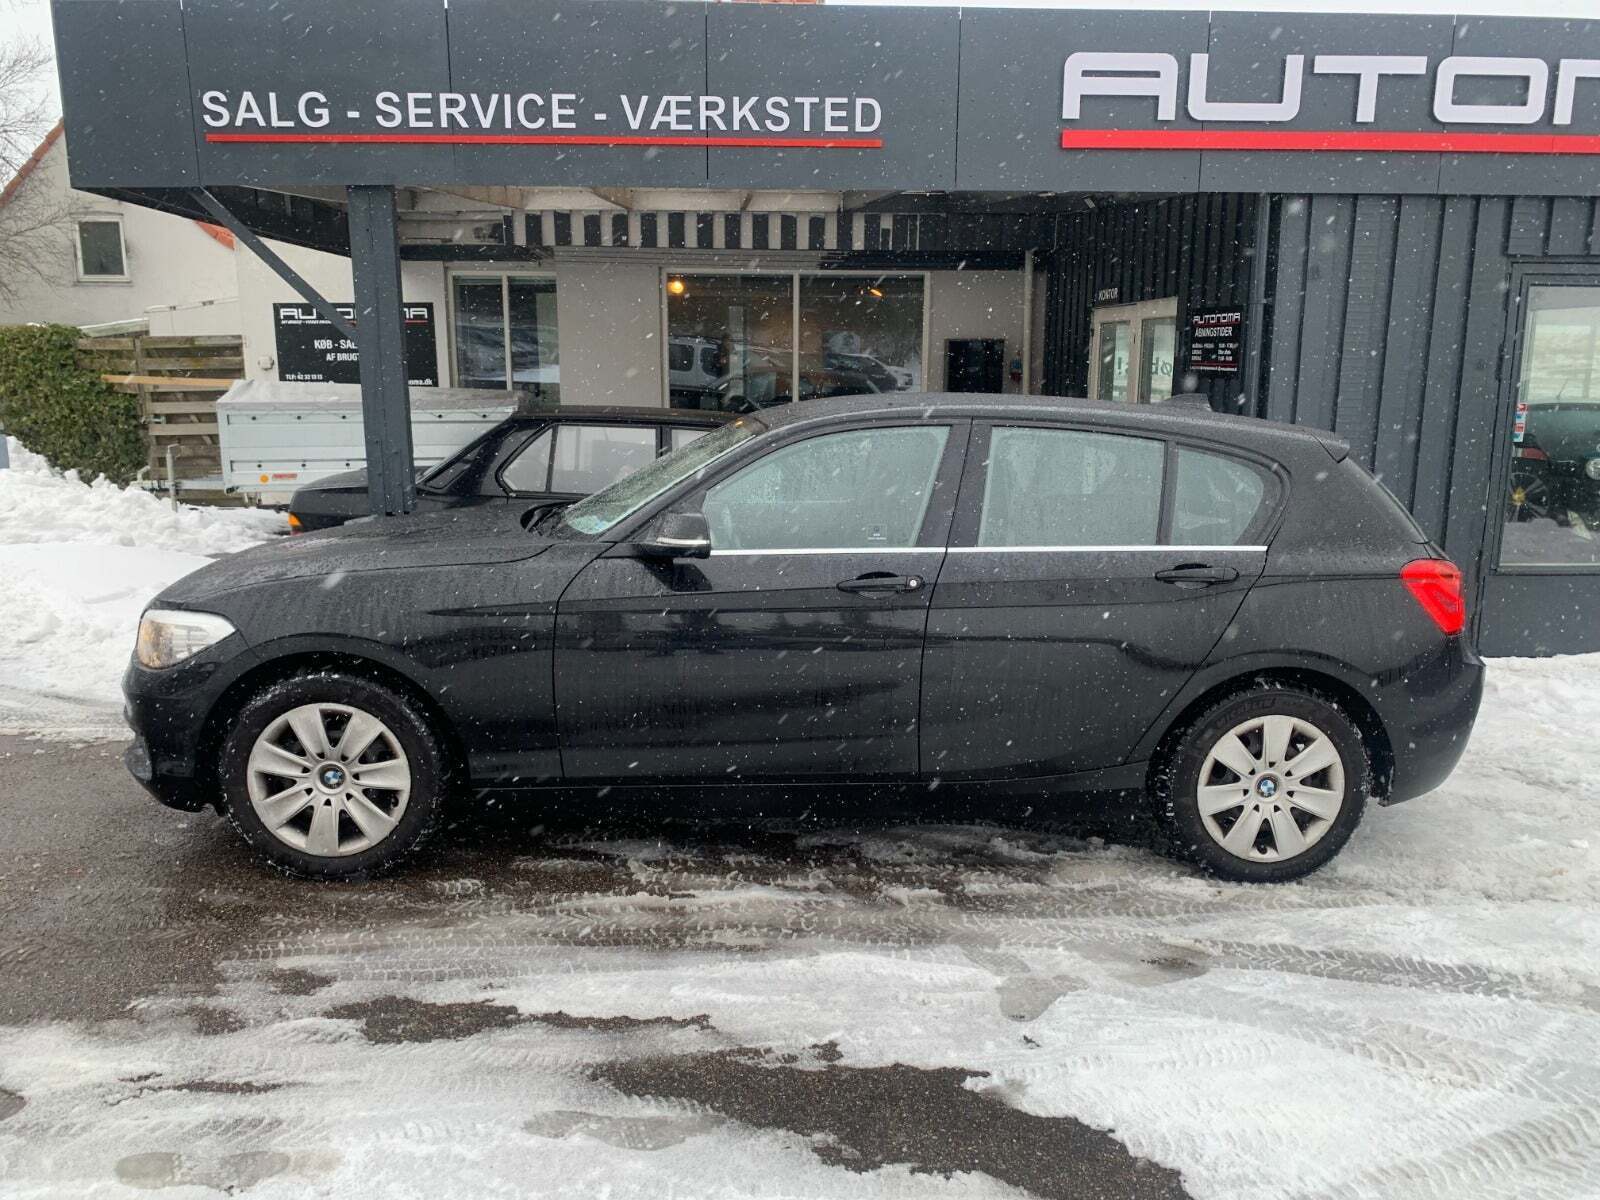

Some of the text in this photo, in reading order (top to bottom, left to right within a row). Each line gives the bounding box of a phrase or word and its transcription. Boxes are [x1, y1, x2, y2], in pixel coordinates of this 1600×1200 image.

[202, 90, 330, 128] SALG
[375, 91, 577, 129] SERVICE
[620, 94, 882, 132] VÆRKSTED
[1193, 312, 1241, 324] AUTONOMA
[314, 339, 333, 349] KØB
[339, 339, 359, 349] SAL
[326, 352, 360, 361] AF BRUG
